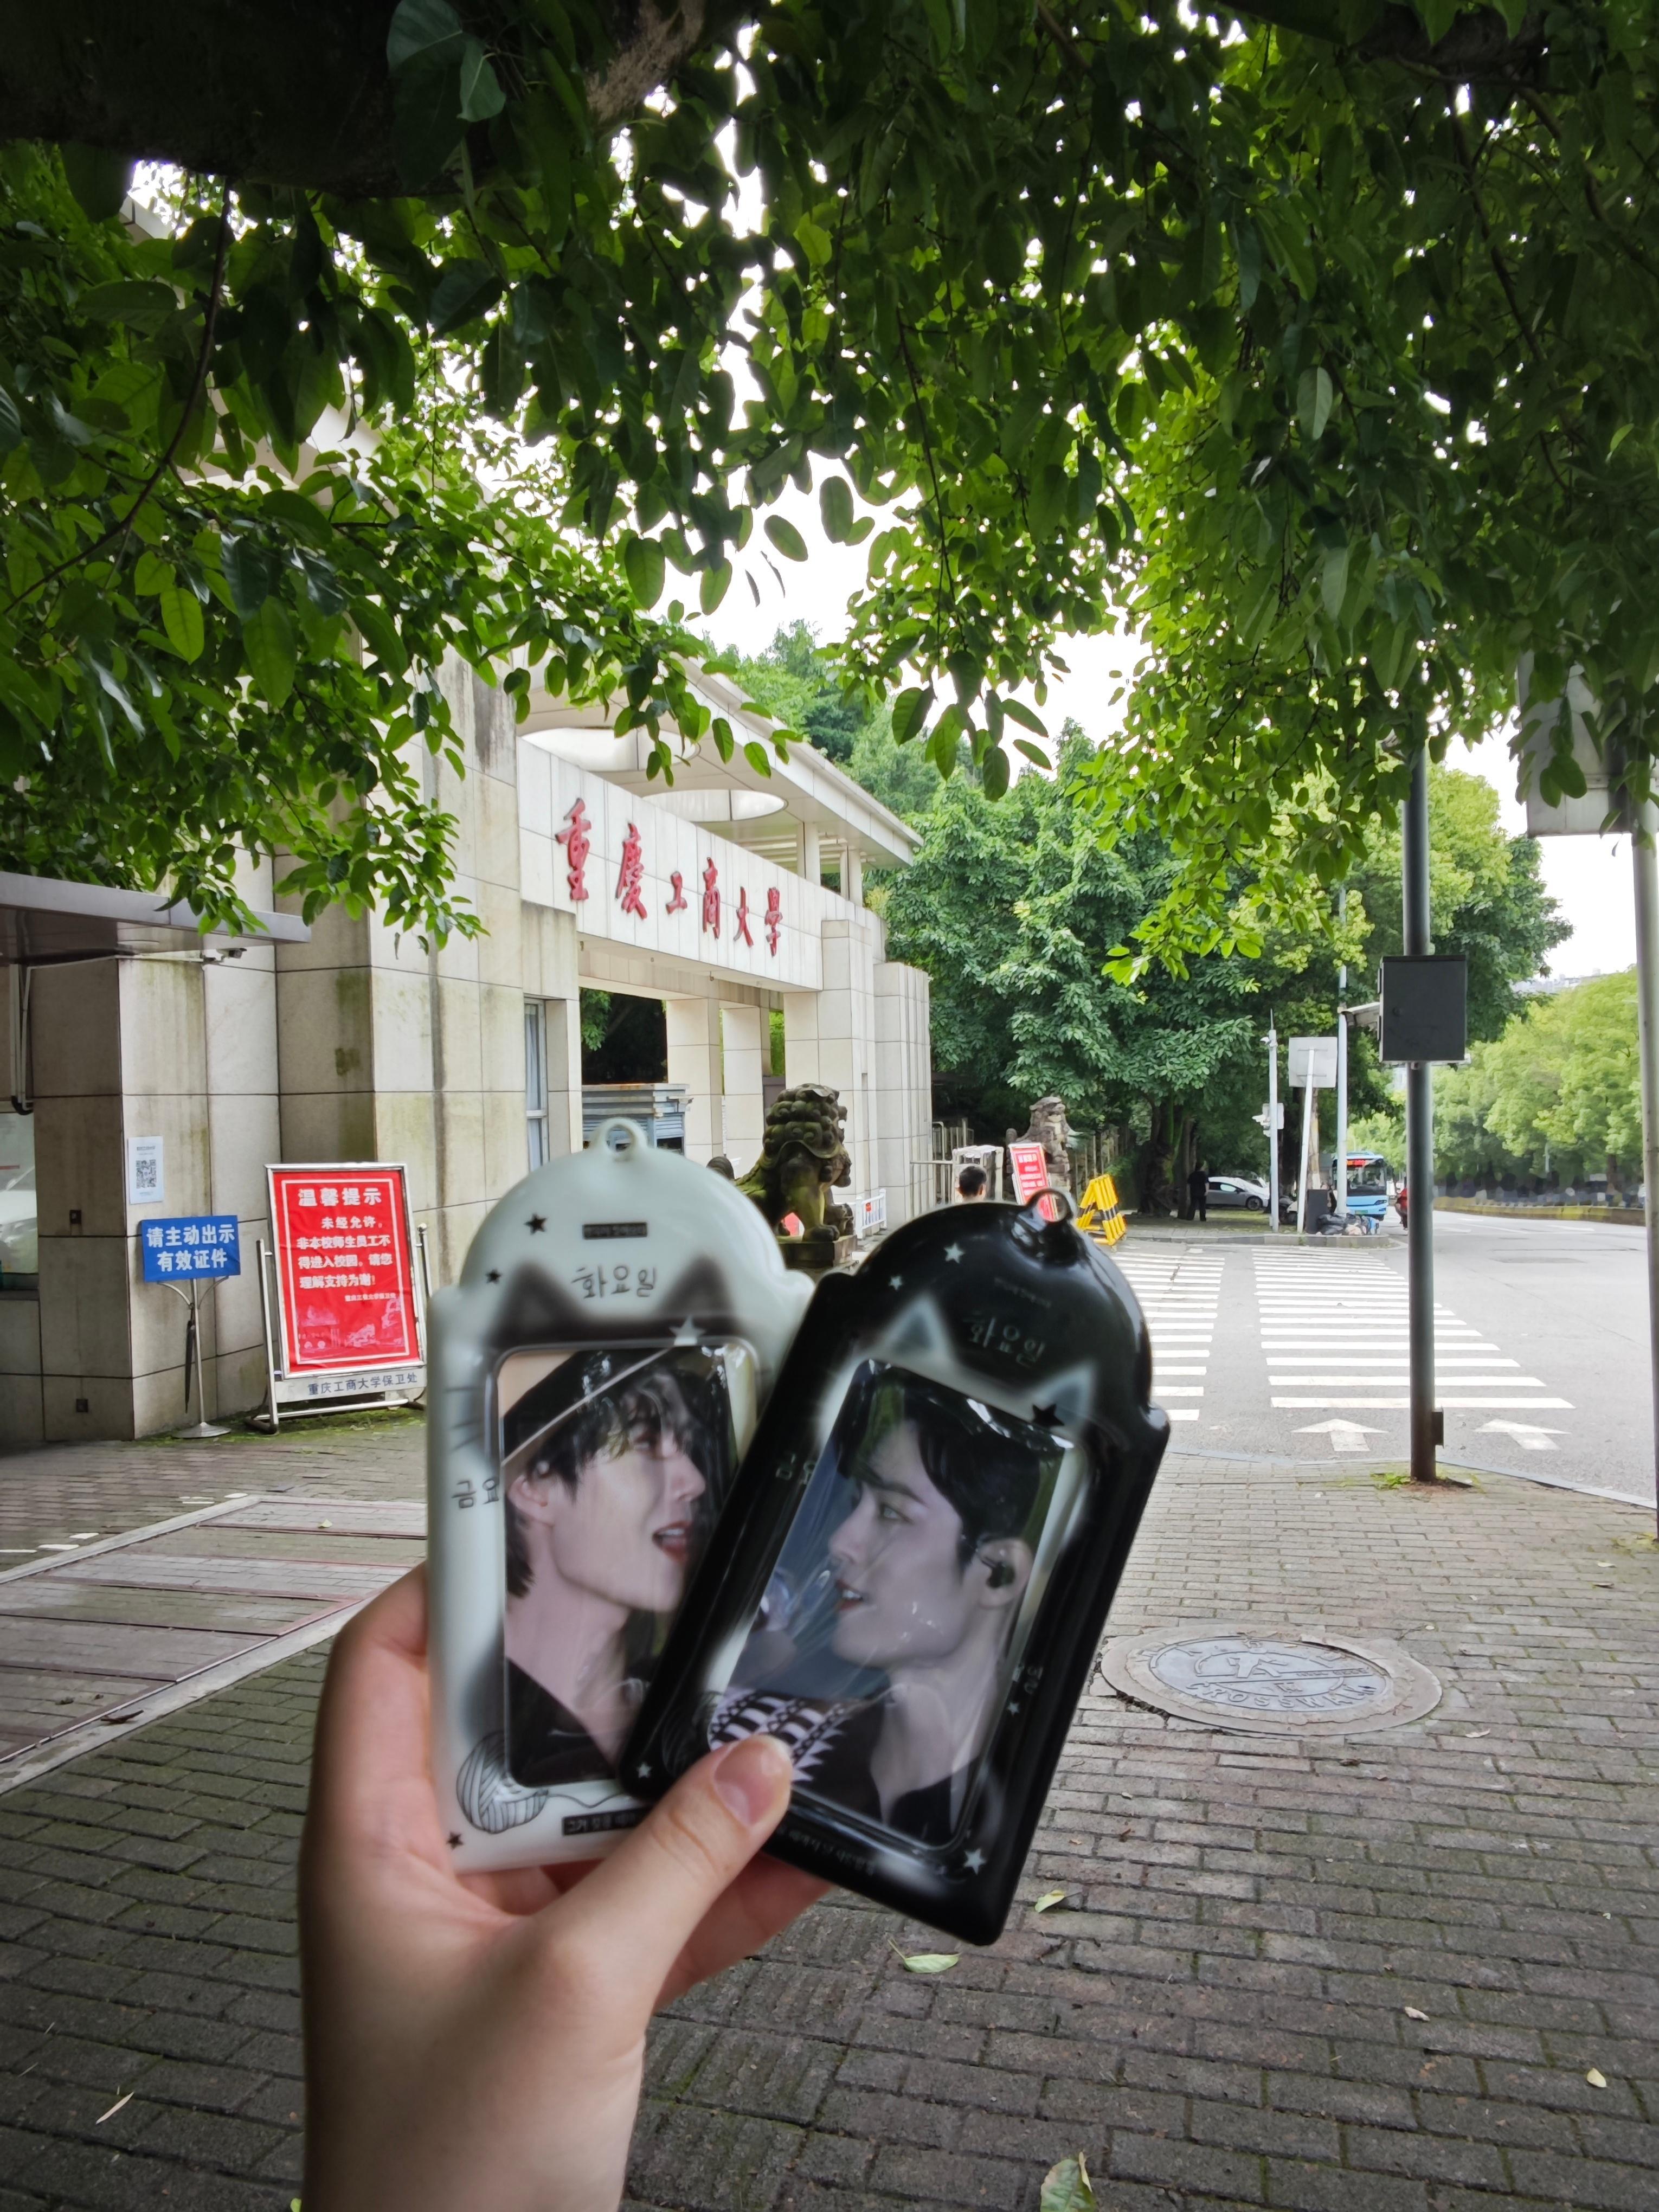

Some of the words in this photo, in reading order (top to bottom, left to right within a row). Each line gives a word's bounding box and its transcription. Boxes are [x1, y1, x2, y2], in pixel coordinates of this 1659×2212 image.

[298, 1187, 382, 1207] 温馨提示
[146, 1224, 235, 1248] 请主动出示
[297, 1234, 391, 1249] 非本校师生员工不
[157, 1248, 228, 1272] 有效证件
[571, 1265, 655, 1299] 화요일
[308, 1372, 417, 1395] 重庆工商大学保卫处
